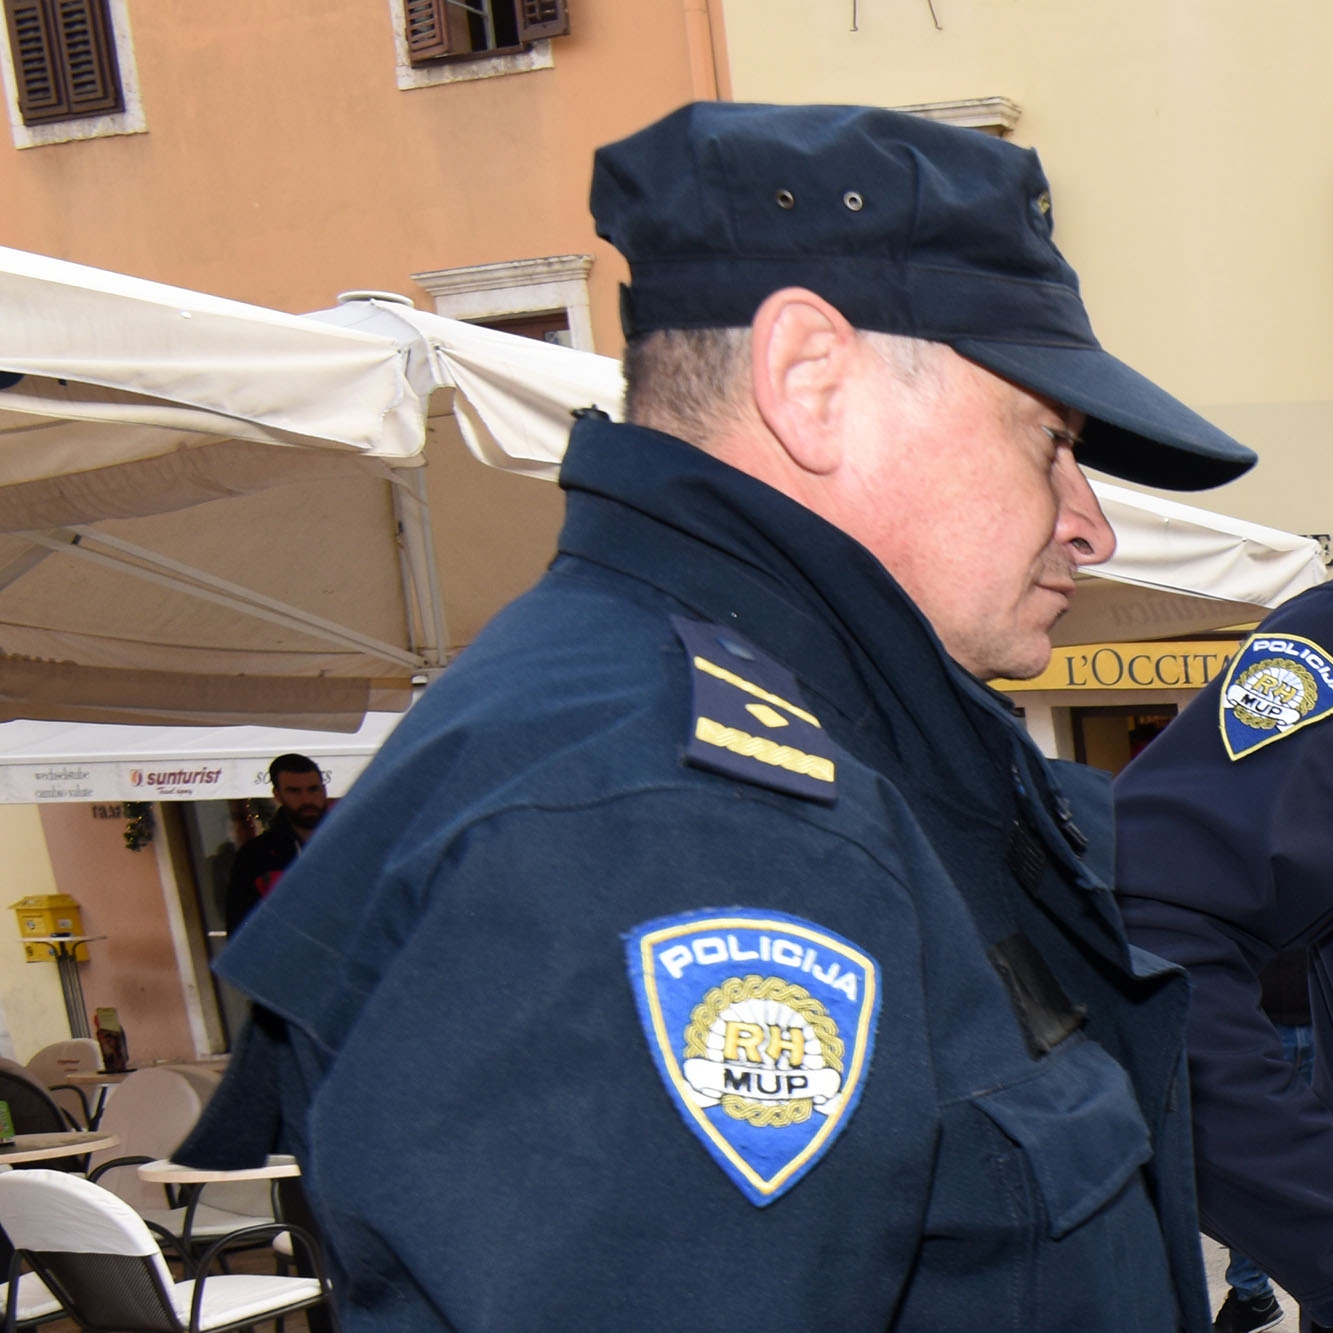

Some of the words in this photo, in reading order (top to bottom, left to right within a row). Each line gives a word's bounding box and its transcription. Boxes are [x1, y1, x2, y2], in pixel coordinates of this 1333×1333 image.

[1252, 673, 1297, 703] RH
[1242, 694, 1283, 715] MUP
[147, 767, 223, 786] sunturist
[659, 934, 862, 1002] POLICIJA
[723, 1021, 806, 1069] RH
[723, 1068, 809, 1096] MUP
